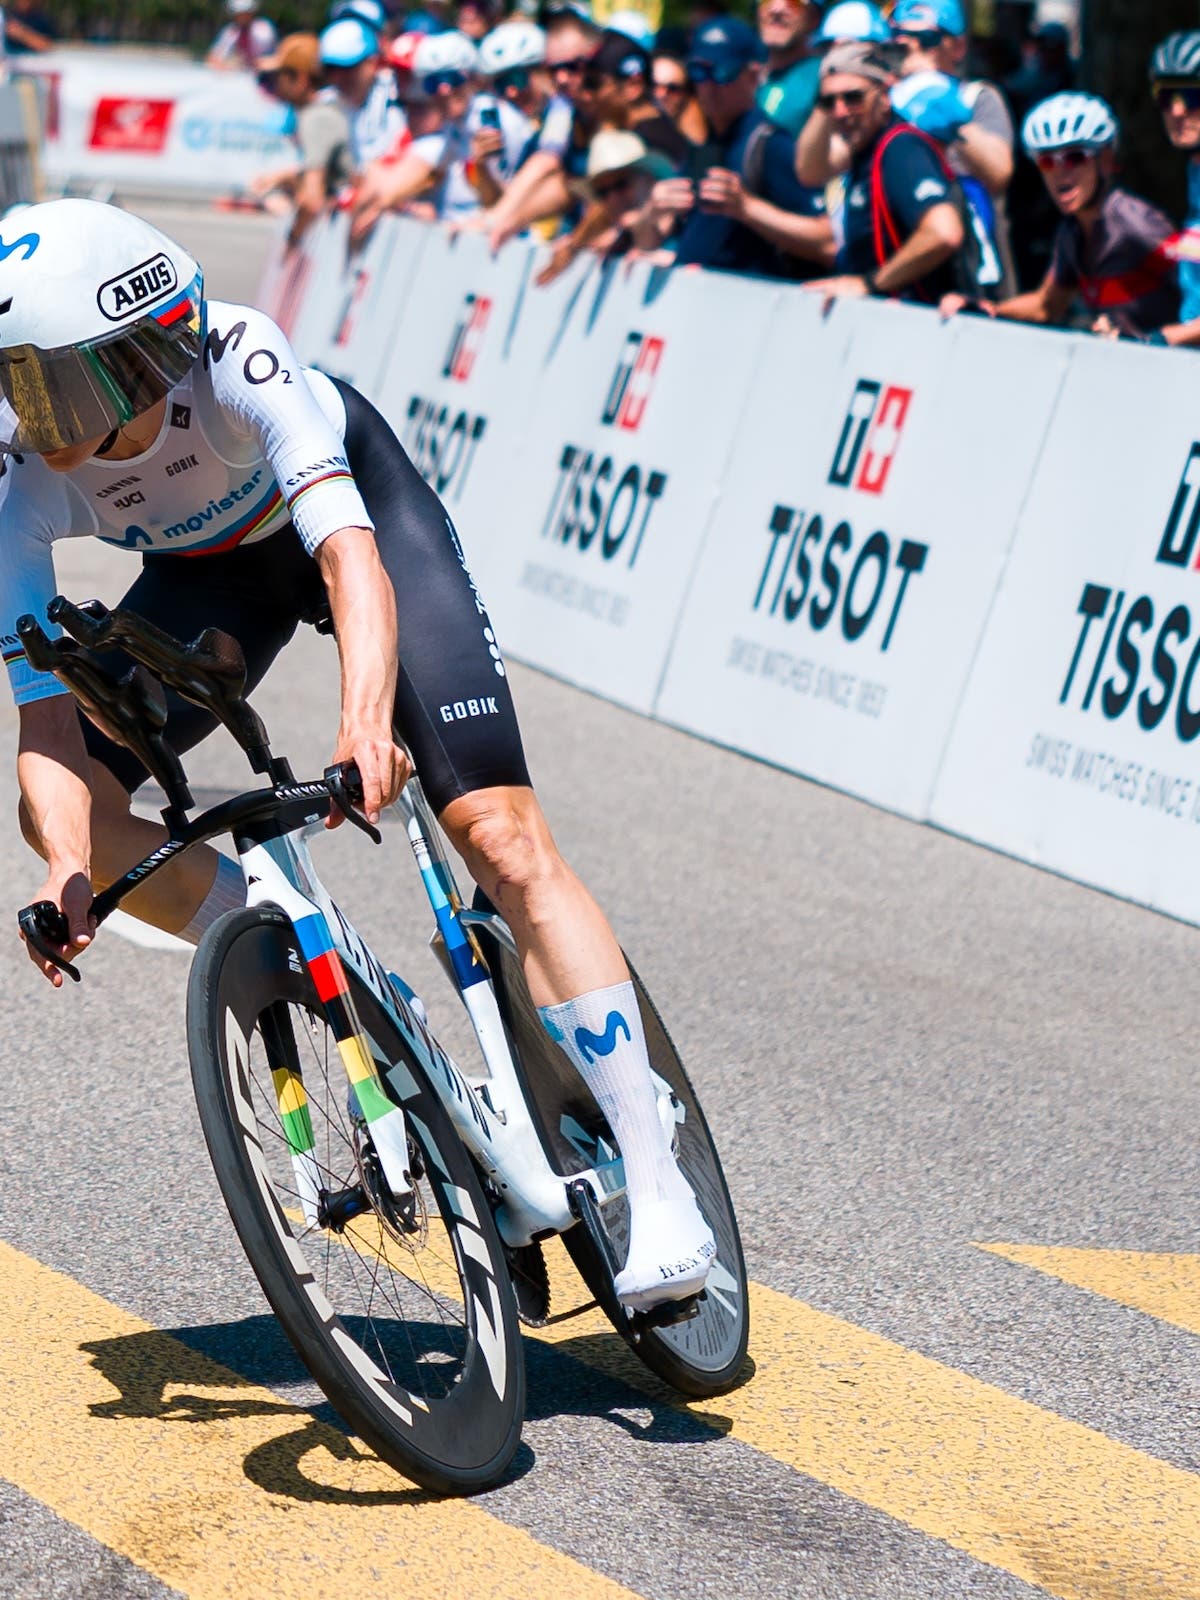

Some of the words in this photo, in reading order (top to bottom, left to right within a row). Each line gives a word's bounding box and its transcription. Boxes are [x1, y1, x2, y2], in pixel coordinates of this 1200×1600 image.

[112, 261, 172, 312] ABUS
[96, 475, 143, 498] CANYON
[165, 453, 200, 477] GOBIK
[162, 469, 262, 539] movistar
[540, 444, 667, 570] TISSOT
[752, 504, 929, 652] TISSOT
[440, 697, 499, 723] GOBIK
[127, 840, 184, 880] CANYON
